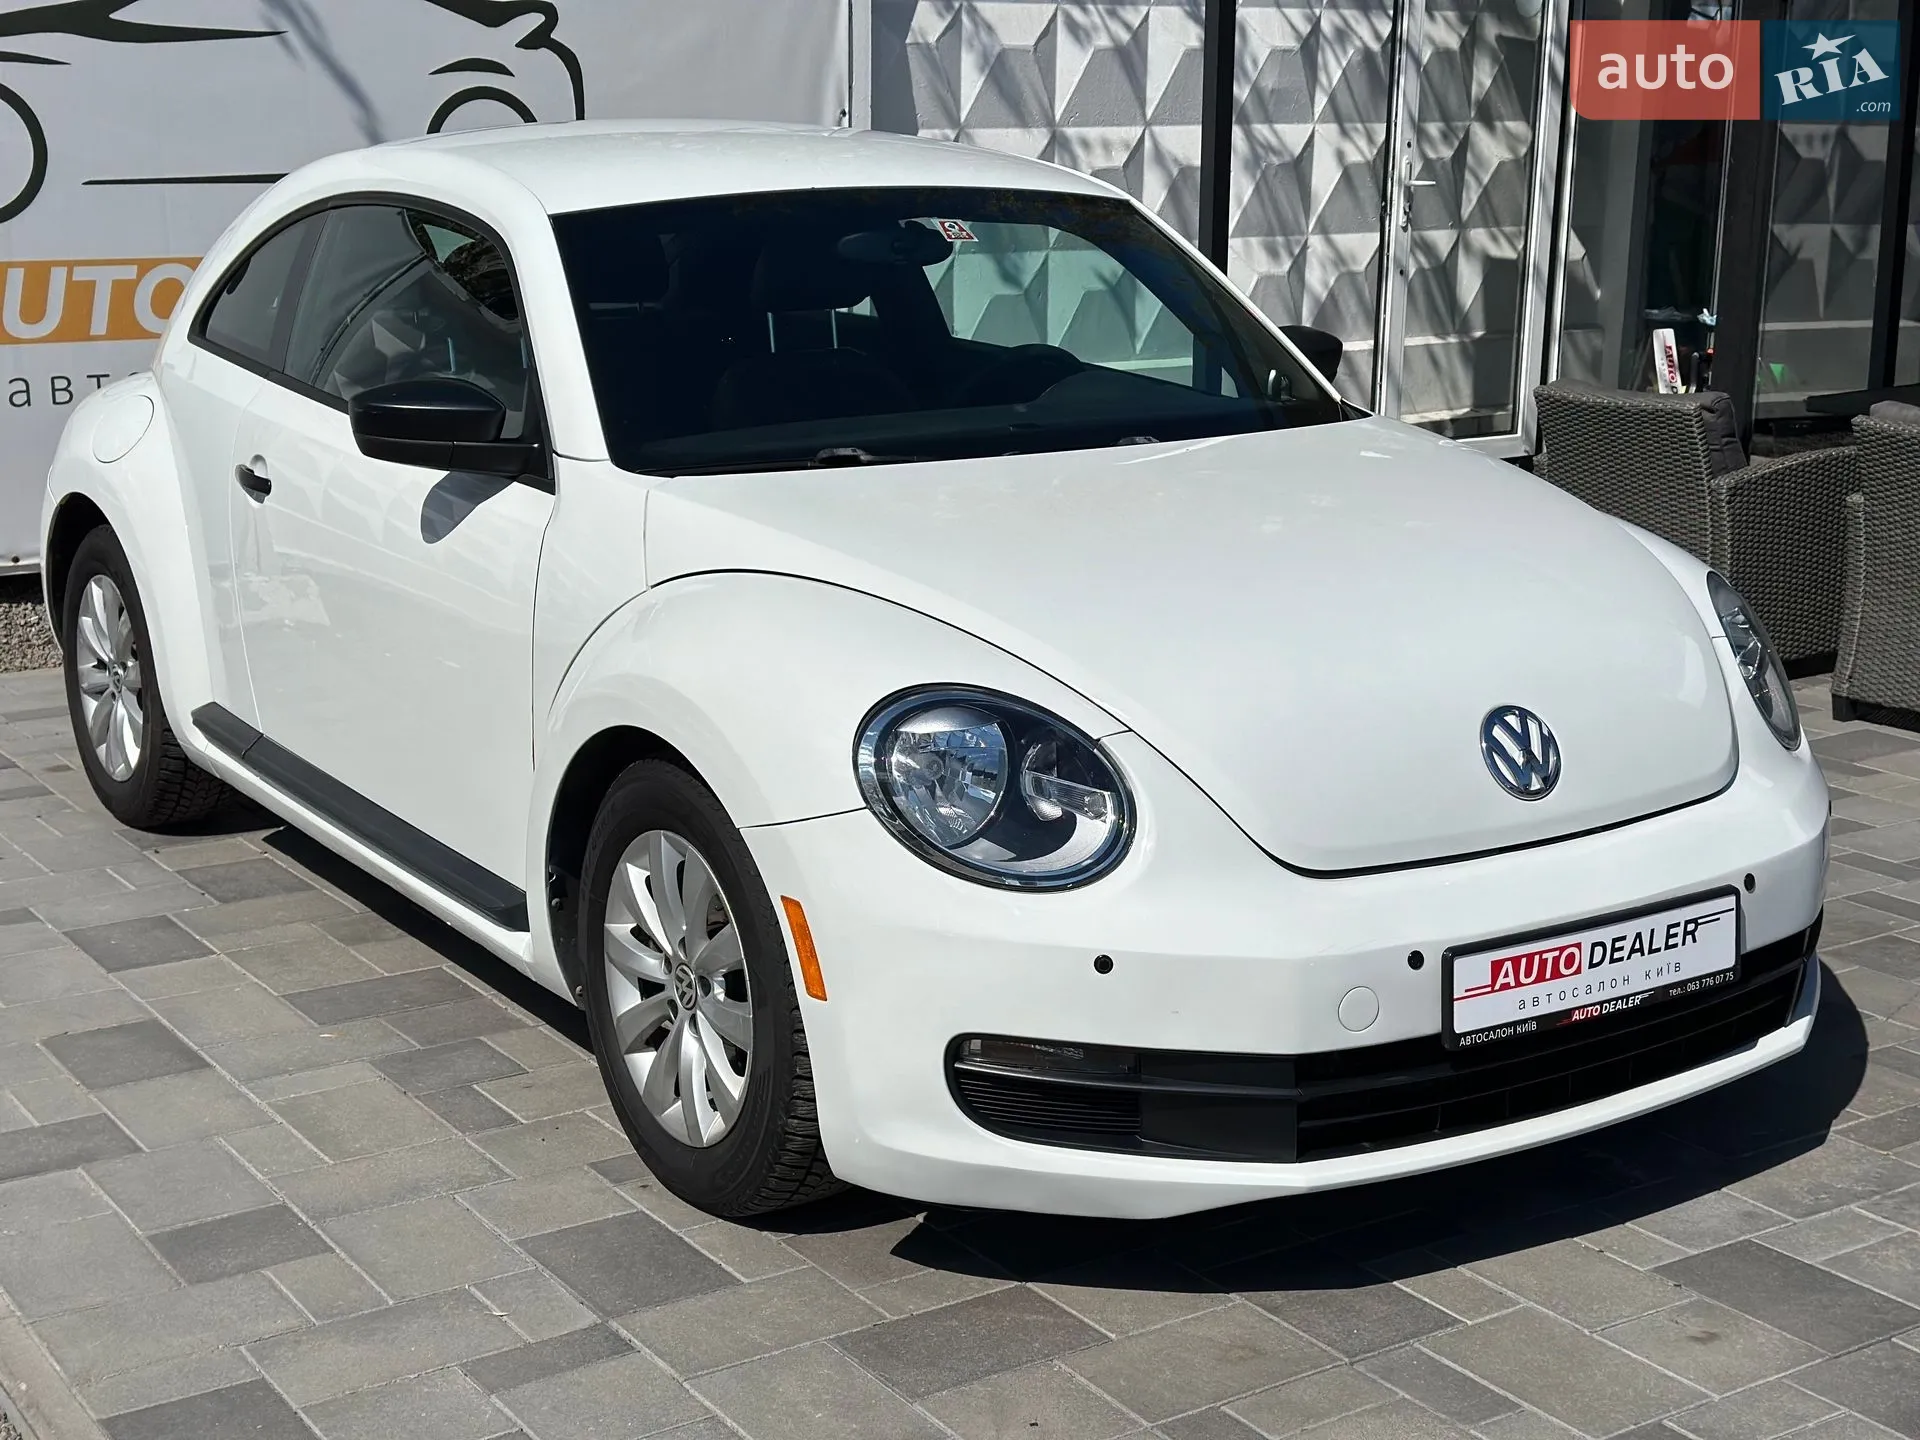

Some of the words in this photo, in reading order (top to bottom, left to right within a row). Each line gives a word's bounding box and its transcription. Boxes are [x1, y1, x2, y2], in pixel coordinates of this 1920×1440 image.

[8, 372, 139, 408] авт
[1493, 946, 1581, 991] AUTO
[1587, 919, 1699, 970] DEALER
[1518, 974, 1630, 1010] автосалон
[1644, 961, 1682, 981] київ
[1686, 980, 1700, 992] 063
[1701, 976, 1715, 988] 776
[1715, 974, 1724, 984] 07
[1725, 971, 1734, 981] 75
[1571, 1005, 1600, 1022] AUTO
[1601, 994, 1642, 1015] DEALER
[1459, 1025, 1514, 1047] АВТОСАЛОН
[1516, 1020, 1537, 1034] КИЇВ
